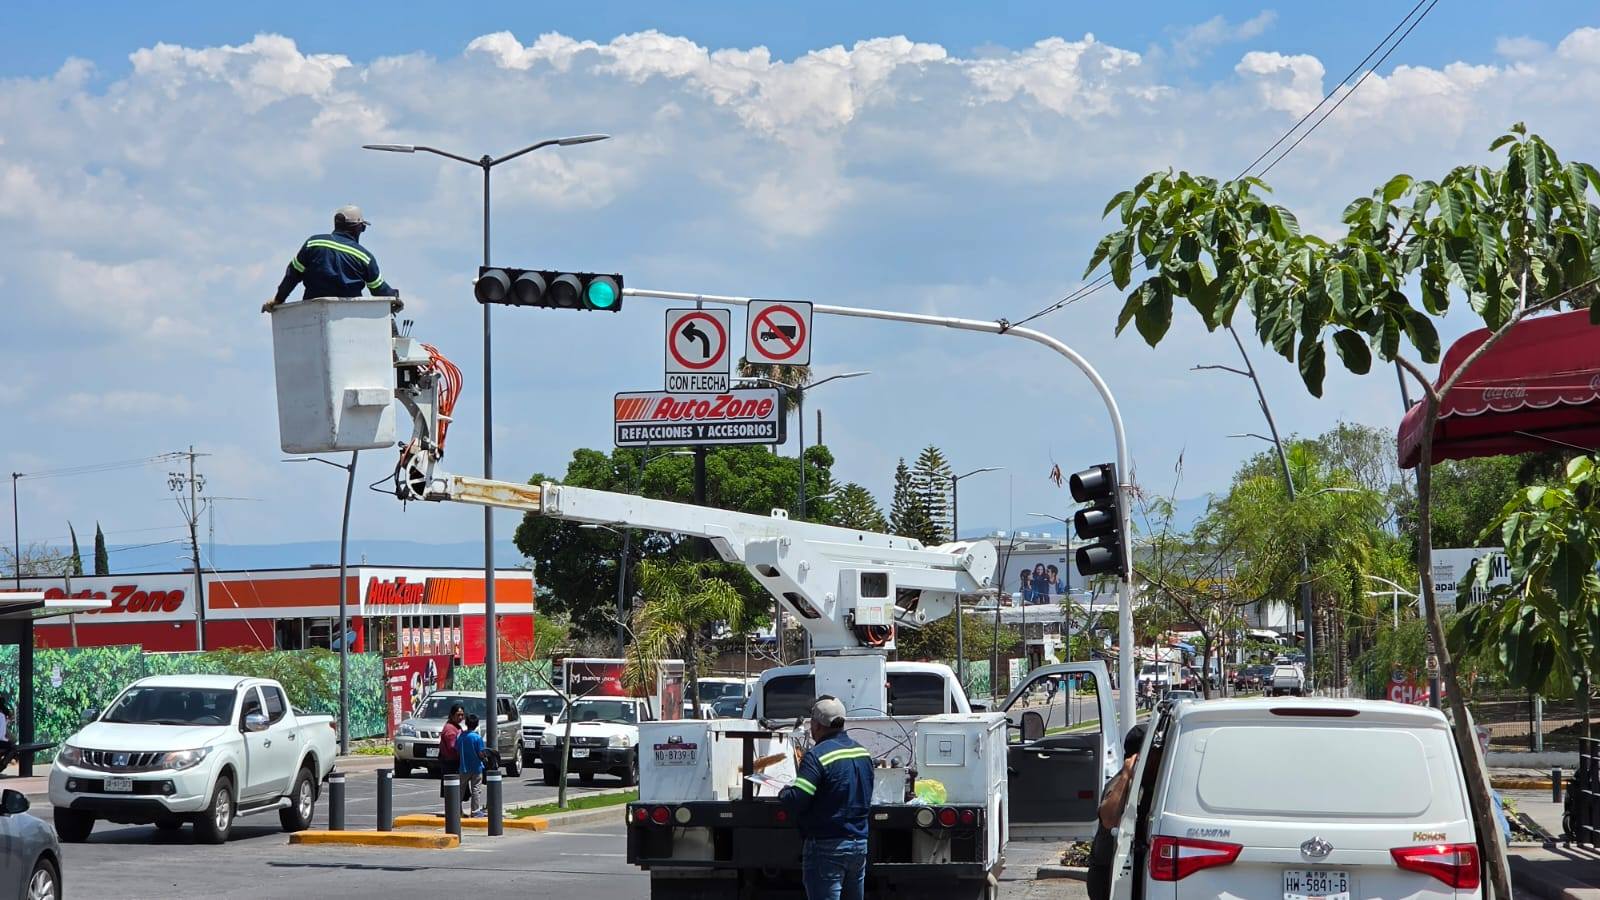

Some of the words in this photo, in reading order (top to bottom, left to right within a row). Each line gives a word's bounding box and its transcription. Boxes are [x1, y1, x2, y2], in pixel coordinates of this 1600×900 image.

[669, 376, 689, 390] CON
[691, 375, 726, 390] FLECHA
[652, 394, 775, 421] AutoZone
[621, 424, 693, 440] REFACCIONES
[697, 425, 706, 437] Y
[707, 423, 773, 437] ACCESORIOS
[364, 576, 425, 605] AutoZone
[1286, 877, 1347, 893] HW-5841-B
